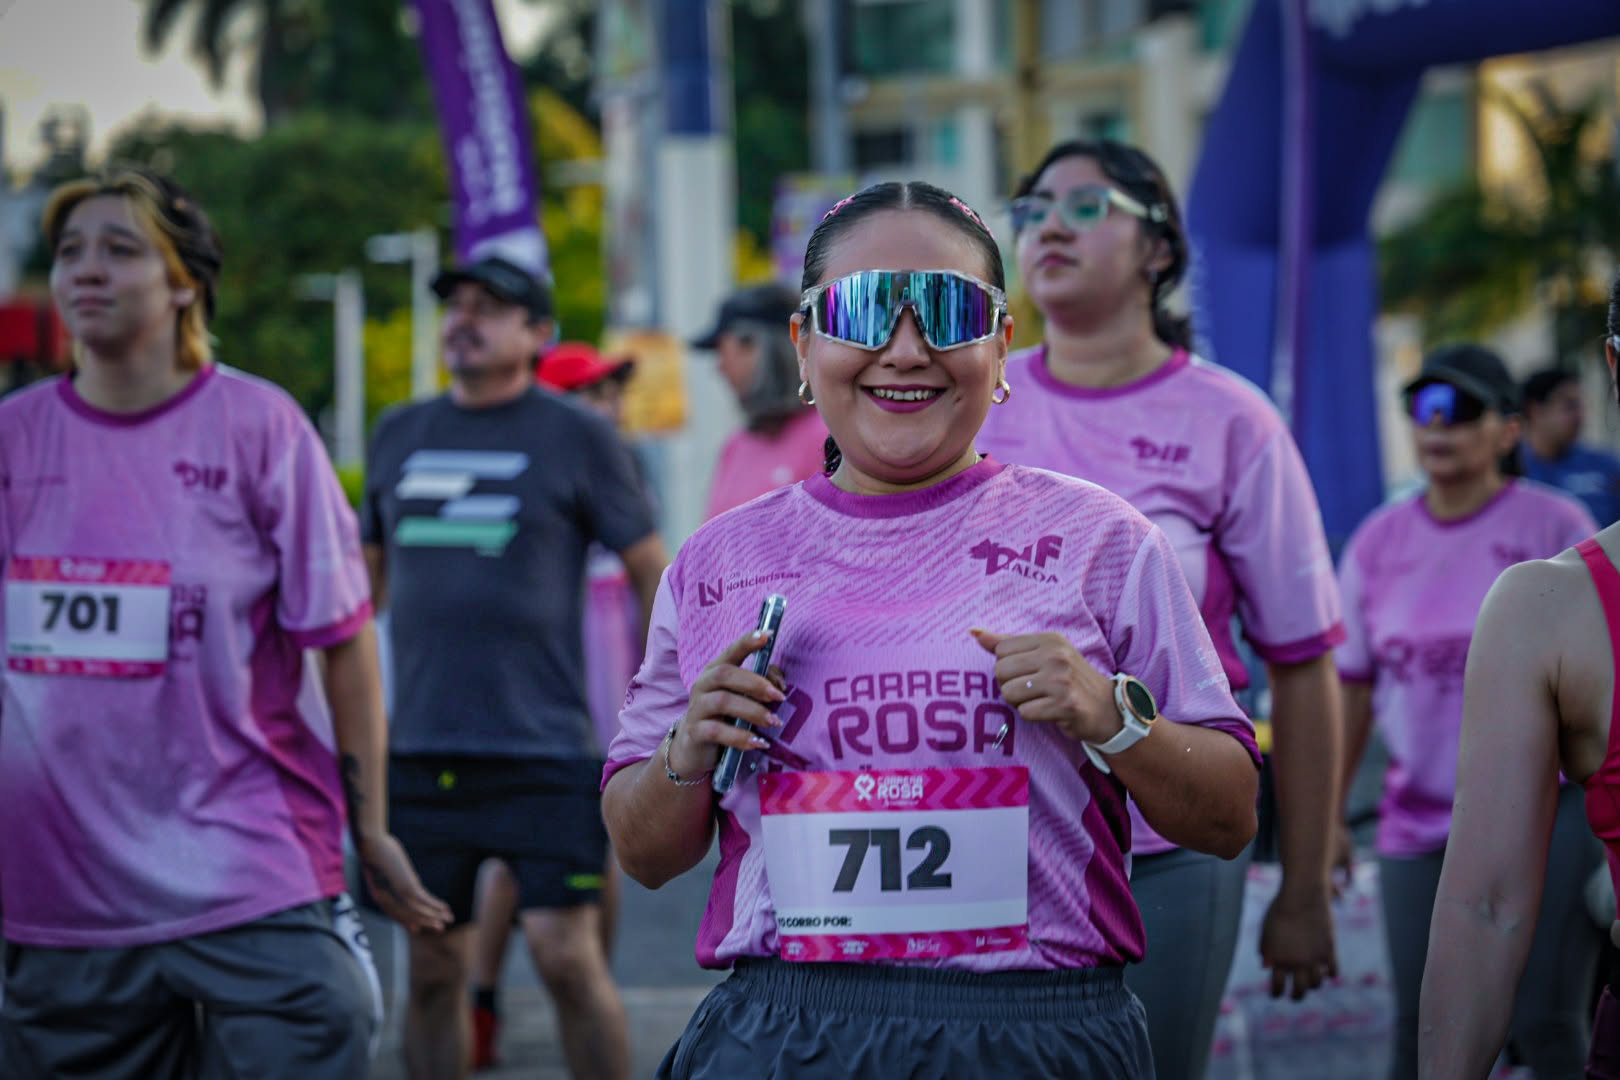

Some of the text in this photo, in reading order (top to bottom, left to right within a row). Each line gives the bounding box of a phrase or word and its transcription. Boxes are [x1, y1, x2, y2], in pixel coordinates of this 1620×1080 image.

[42, 592, 120, 635] 701
[827, 701, 1016, 760] ROSA
[877, 784, 923, 800] ROSA
[829, 825, 952, 893] 712
[786, 917, 822, 928] CORRO
